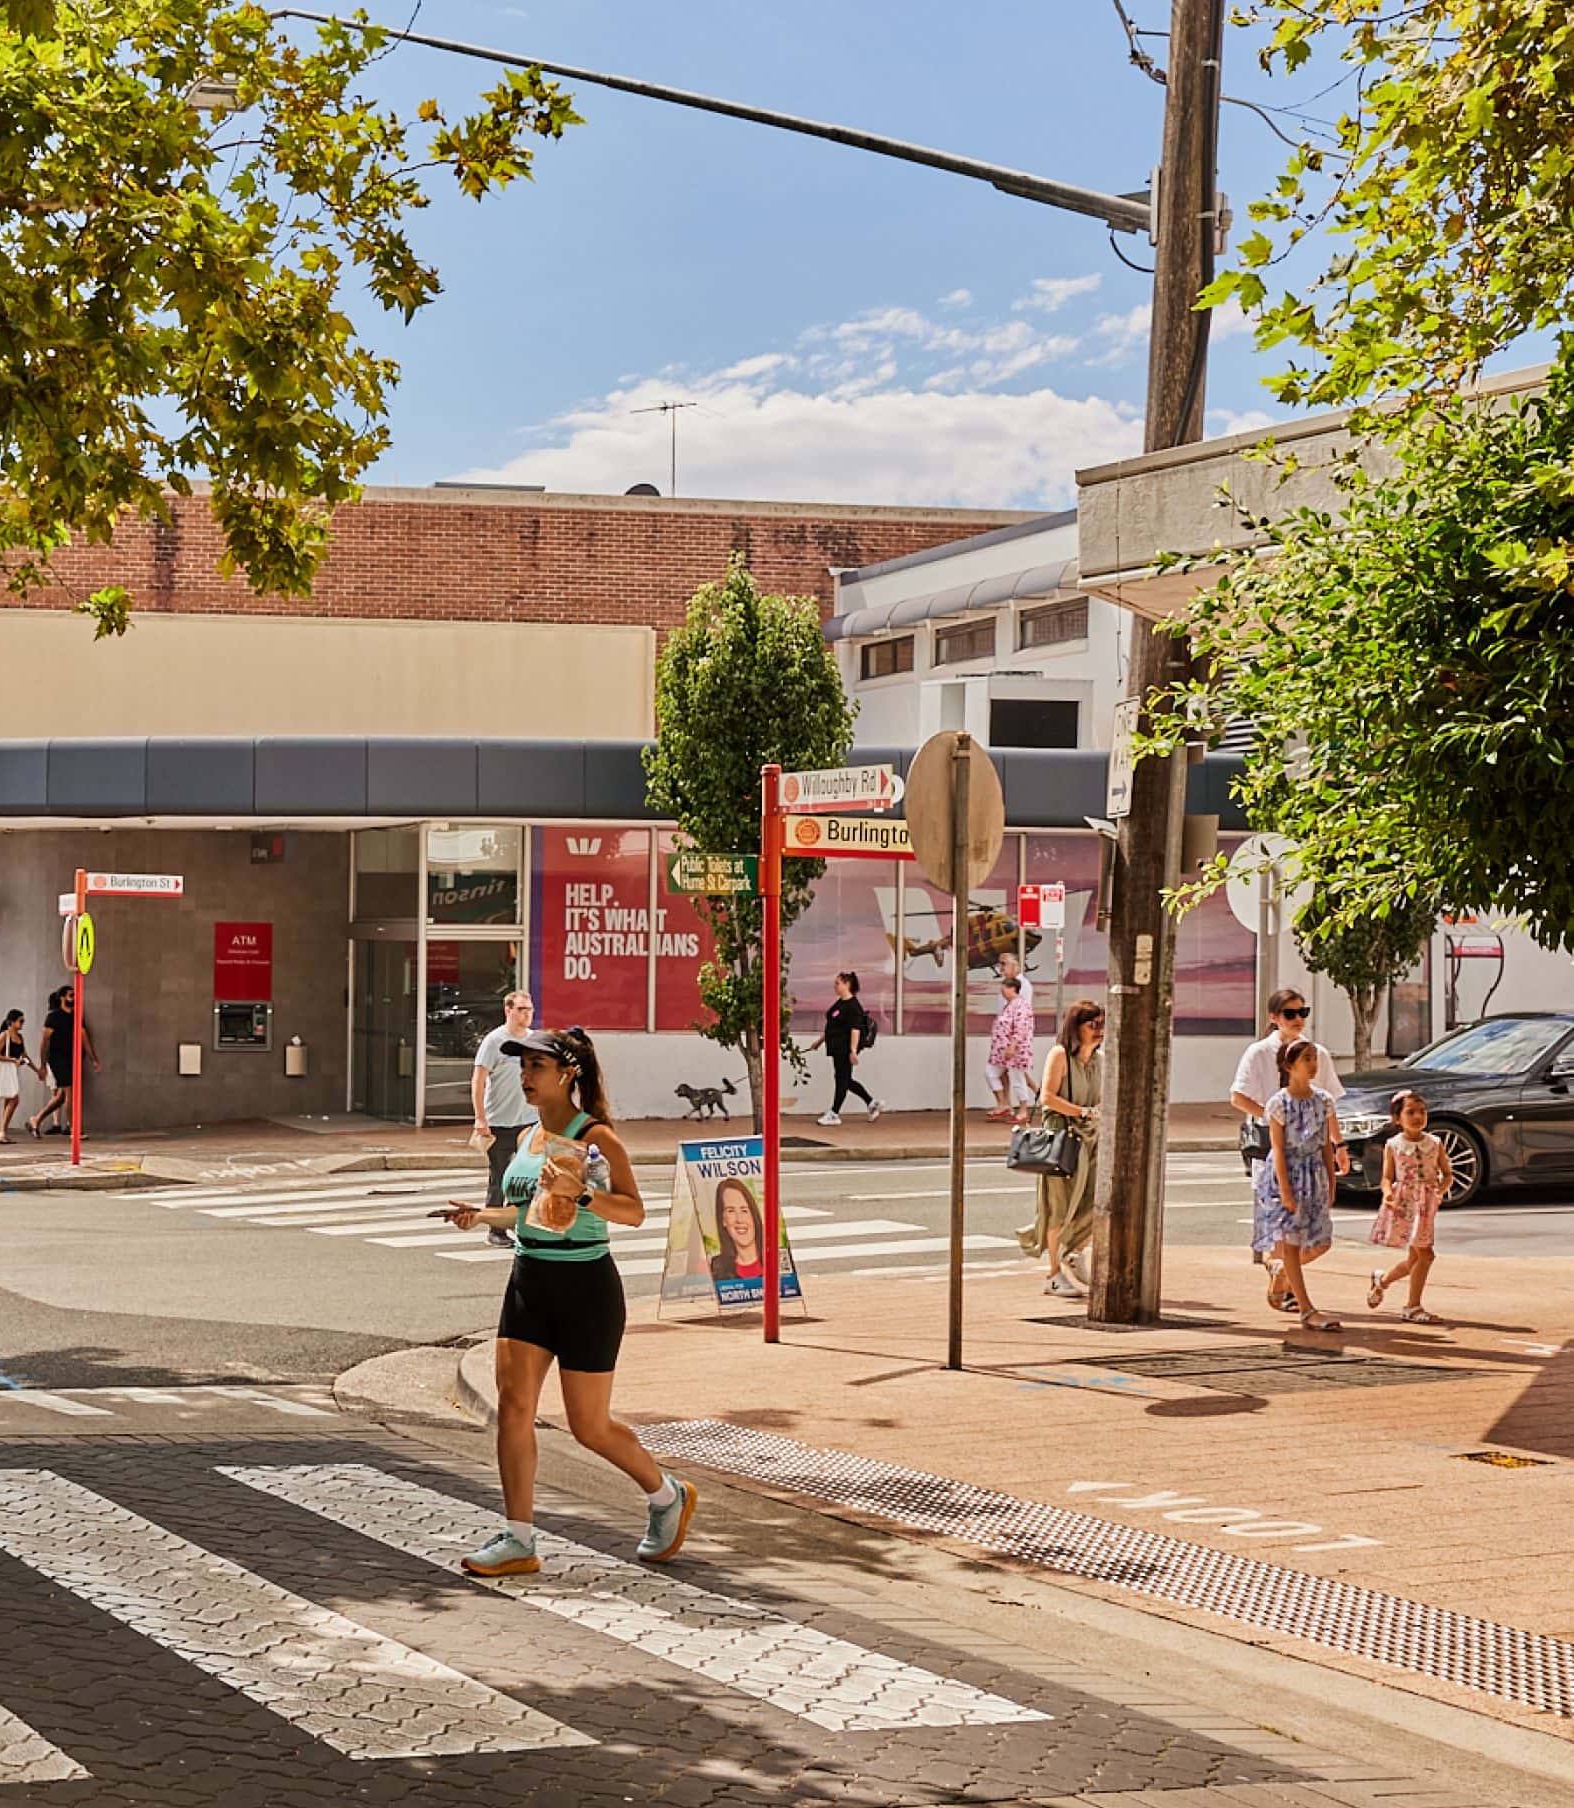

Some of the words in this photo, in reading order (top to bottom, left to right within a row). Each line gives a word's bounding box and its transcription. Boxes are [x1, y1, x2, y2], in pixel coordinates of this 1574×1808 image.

[801, 774, 858, 800] Willoughby
[861, 771, 876, 792] Rd
[828, 819, 908, 848] Burlingto
[681, 856, 705, 873] Public
[707, 856, 732, 873] Toilets
[734, 859, 744, 874] at
[110, 876, 157, 889] Burlington
[159, 877, 170, 889] St
[681, 873, 706, 889] Hume
[718, 874, 751, 894] Carpark
[565, 883, 619, 907] HELP.
[604, 908, 667, 931] WHAT
[232, 936, 256, 945] ATM
[564, 932, 699, 957] AUSTRALIANS
[564, 957, 597, 980] DO.
[700, 1144, 747, 1159] FELICITY
[697, 1159, 761, 1178] WILSON
[1095, 1490, 1386, 1552] LOOK
